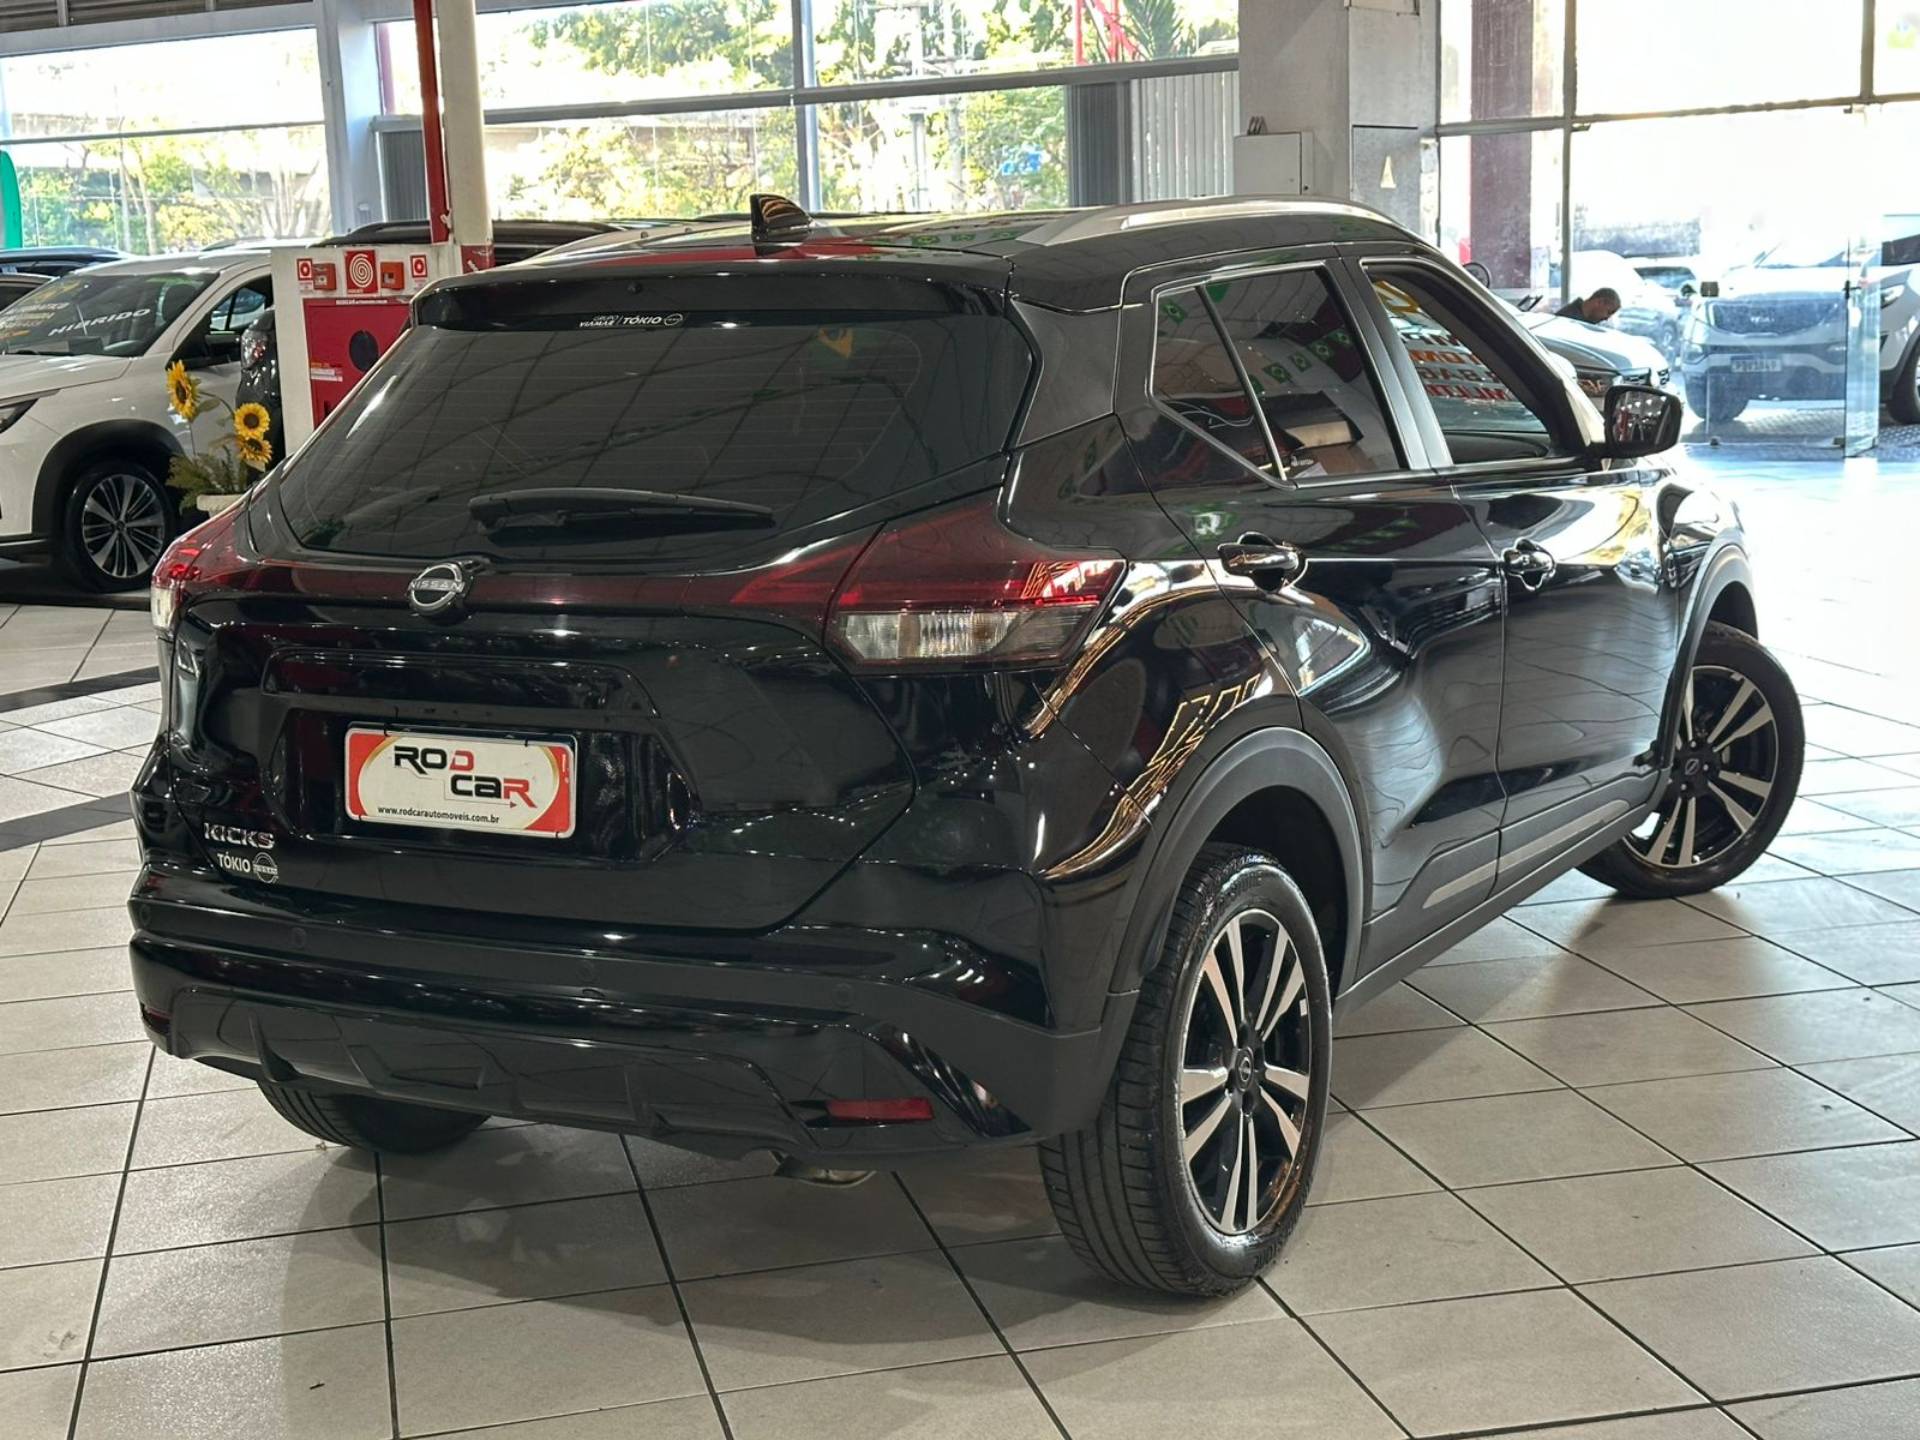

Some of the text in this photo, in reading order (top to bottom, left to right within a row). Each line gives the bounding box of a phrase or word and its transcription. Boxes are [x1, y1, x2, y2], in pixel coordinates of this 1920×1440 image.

[622, 315, 662, 325] TÓKIO
[407, 579, 466, 593] NISSAN
[394, 745, 475, 775] ROD
[377, 805, 500, 824] www.rodcarautomoveis.com.br
[203, 822, 276, 850] KICKS
[216, 851, 251, 873] TÓKIO
